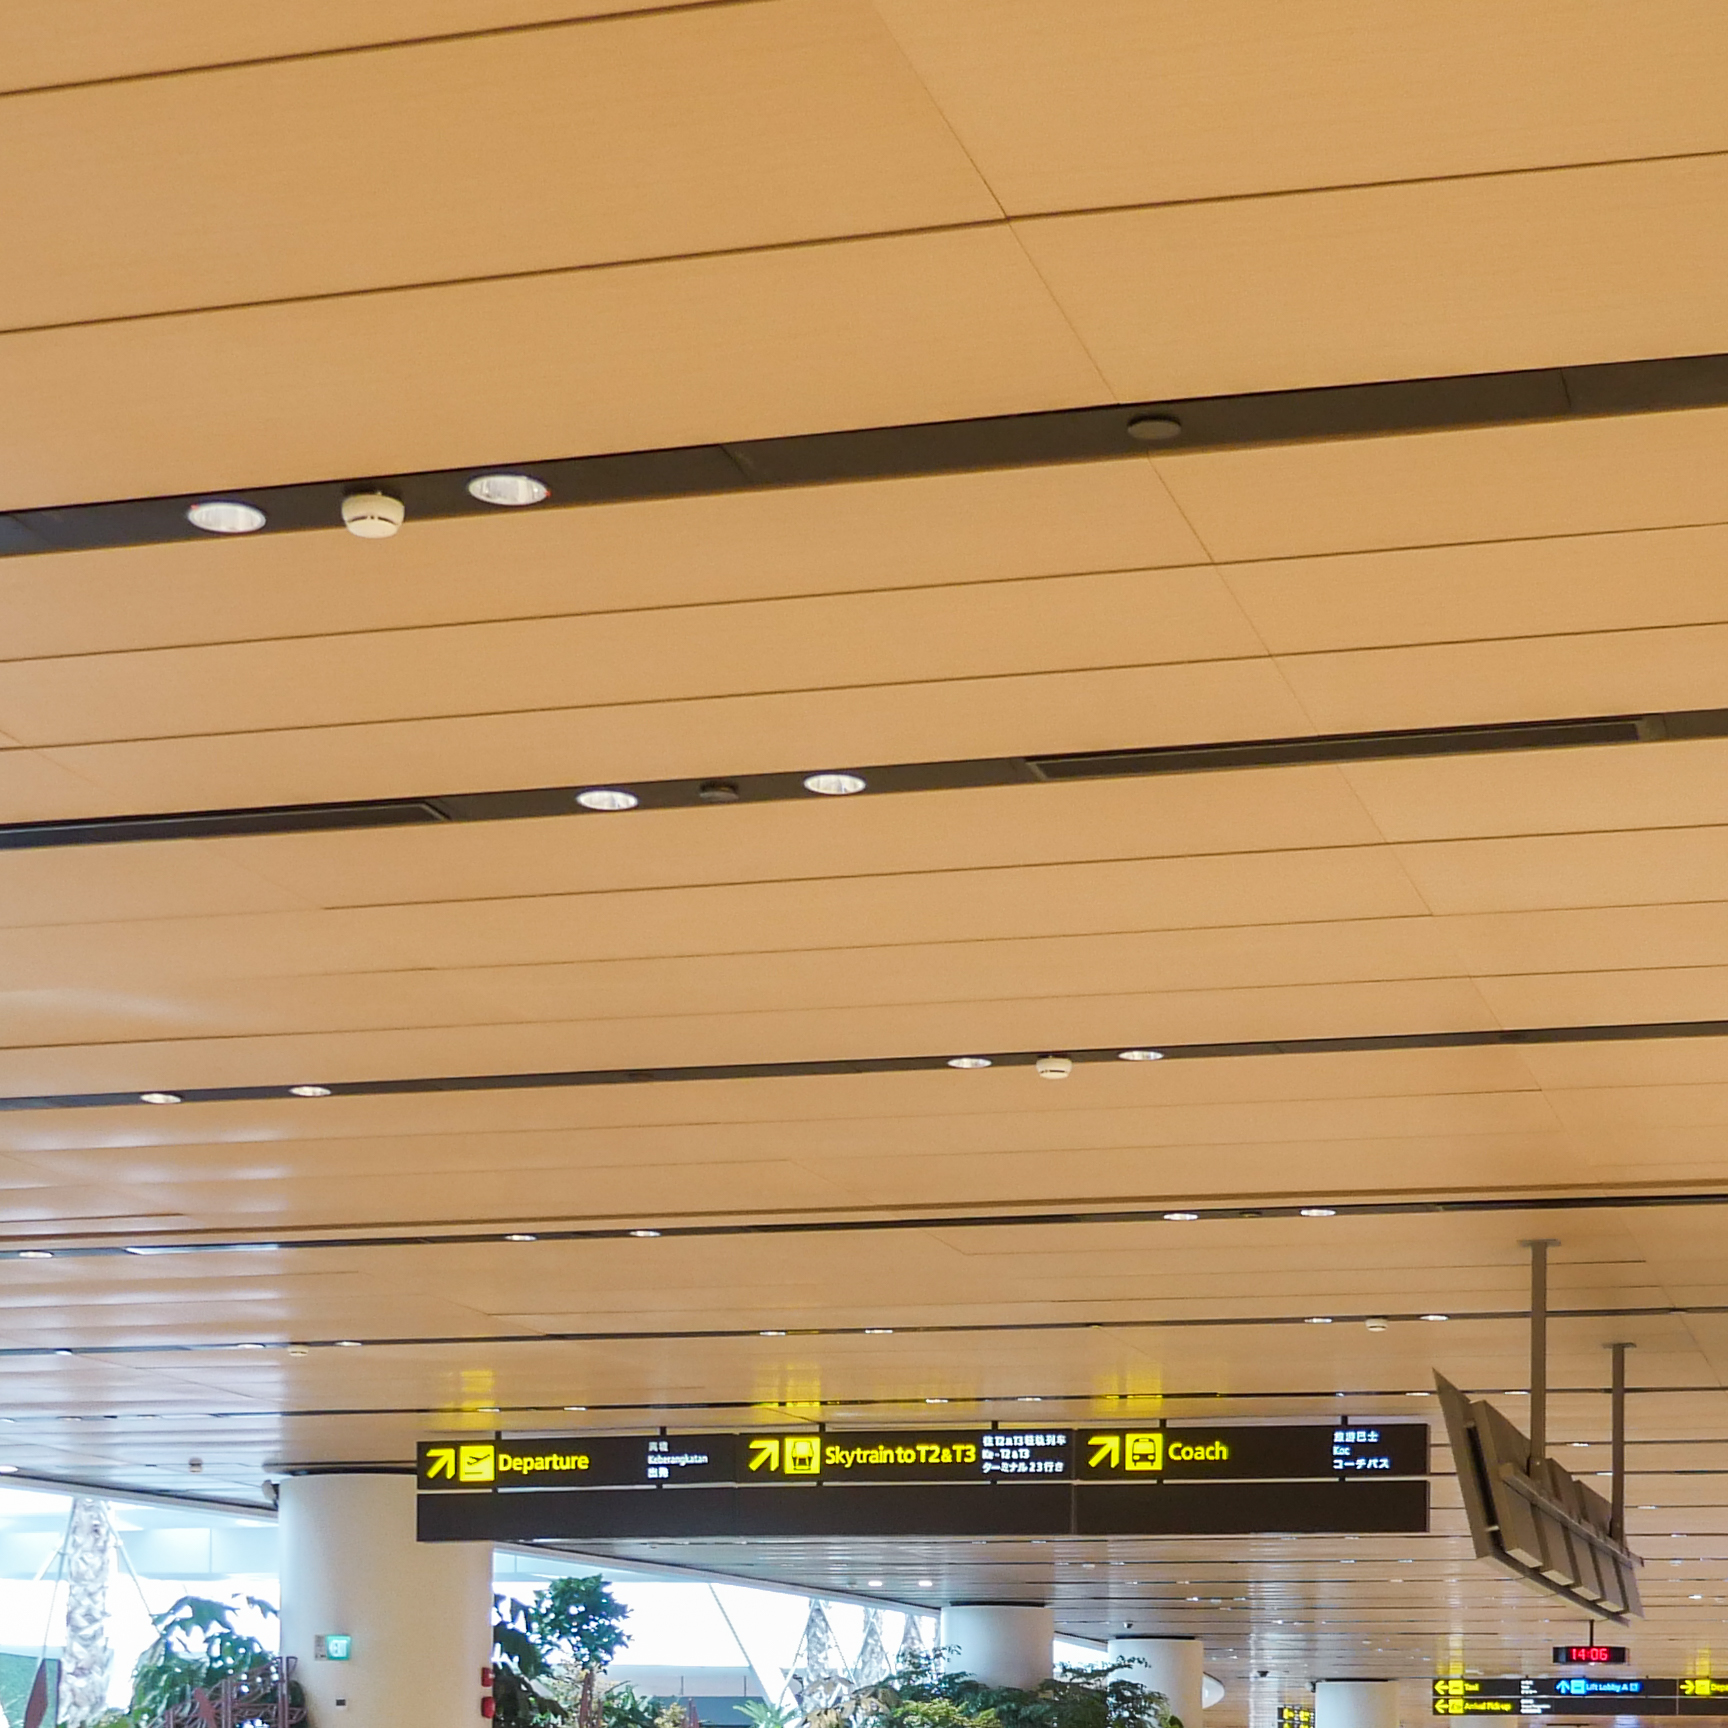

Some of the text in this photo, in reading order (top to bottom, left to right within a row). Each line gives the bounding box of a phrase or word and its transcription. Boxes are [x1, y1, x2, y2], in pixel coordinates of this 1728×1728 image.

[825, 1444, 894, 1468] Skytrain
[895, 1446, 916, 1463] to
[1168, 1440, 1229, 1461] Coach
[1332, 1445, 1351, 1456] Koc
[498, 1453, 590, 1475] Departure
[1572, 1648, 1609, 1661] 14:06
